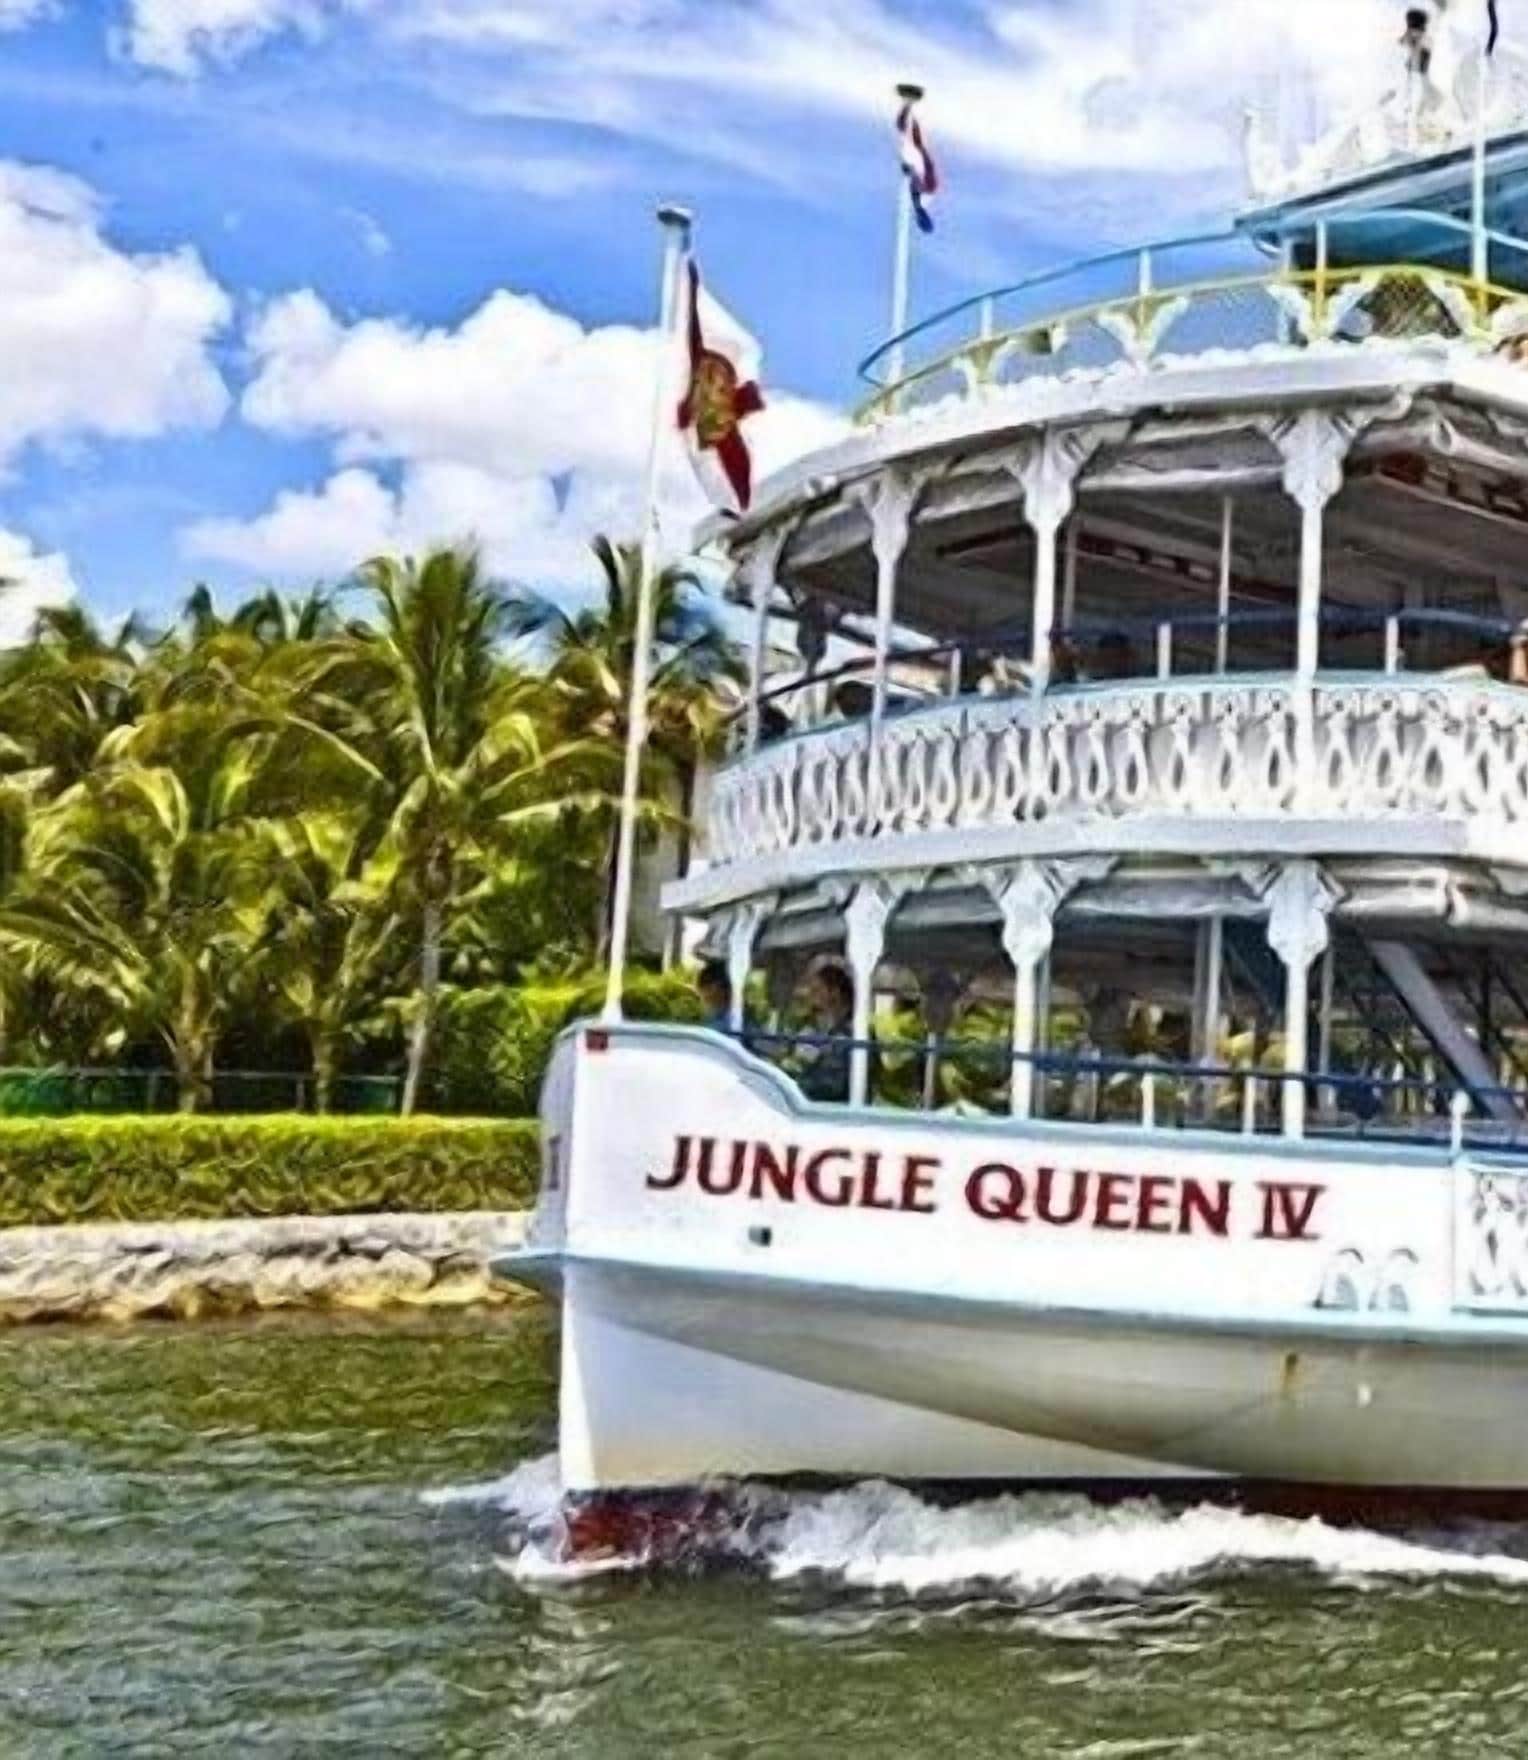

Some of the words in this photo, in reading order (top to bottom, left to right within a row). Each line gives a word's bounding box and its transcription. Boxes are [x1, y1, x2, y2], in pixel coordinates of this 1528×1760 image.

[646, 1135, 940, 1214] JUNGLE
[965, 1163, 1231, 1238] QUEEN
[1254, 1181, 1327, 1242] IV
